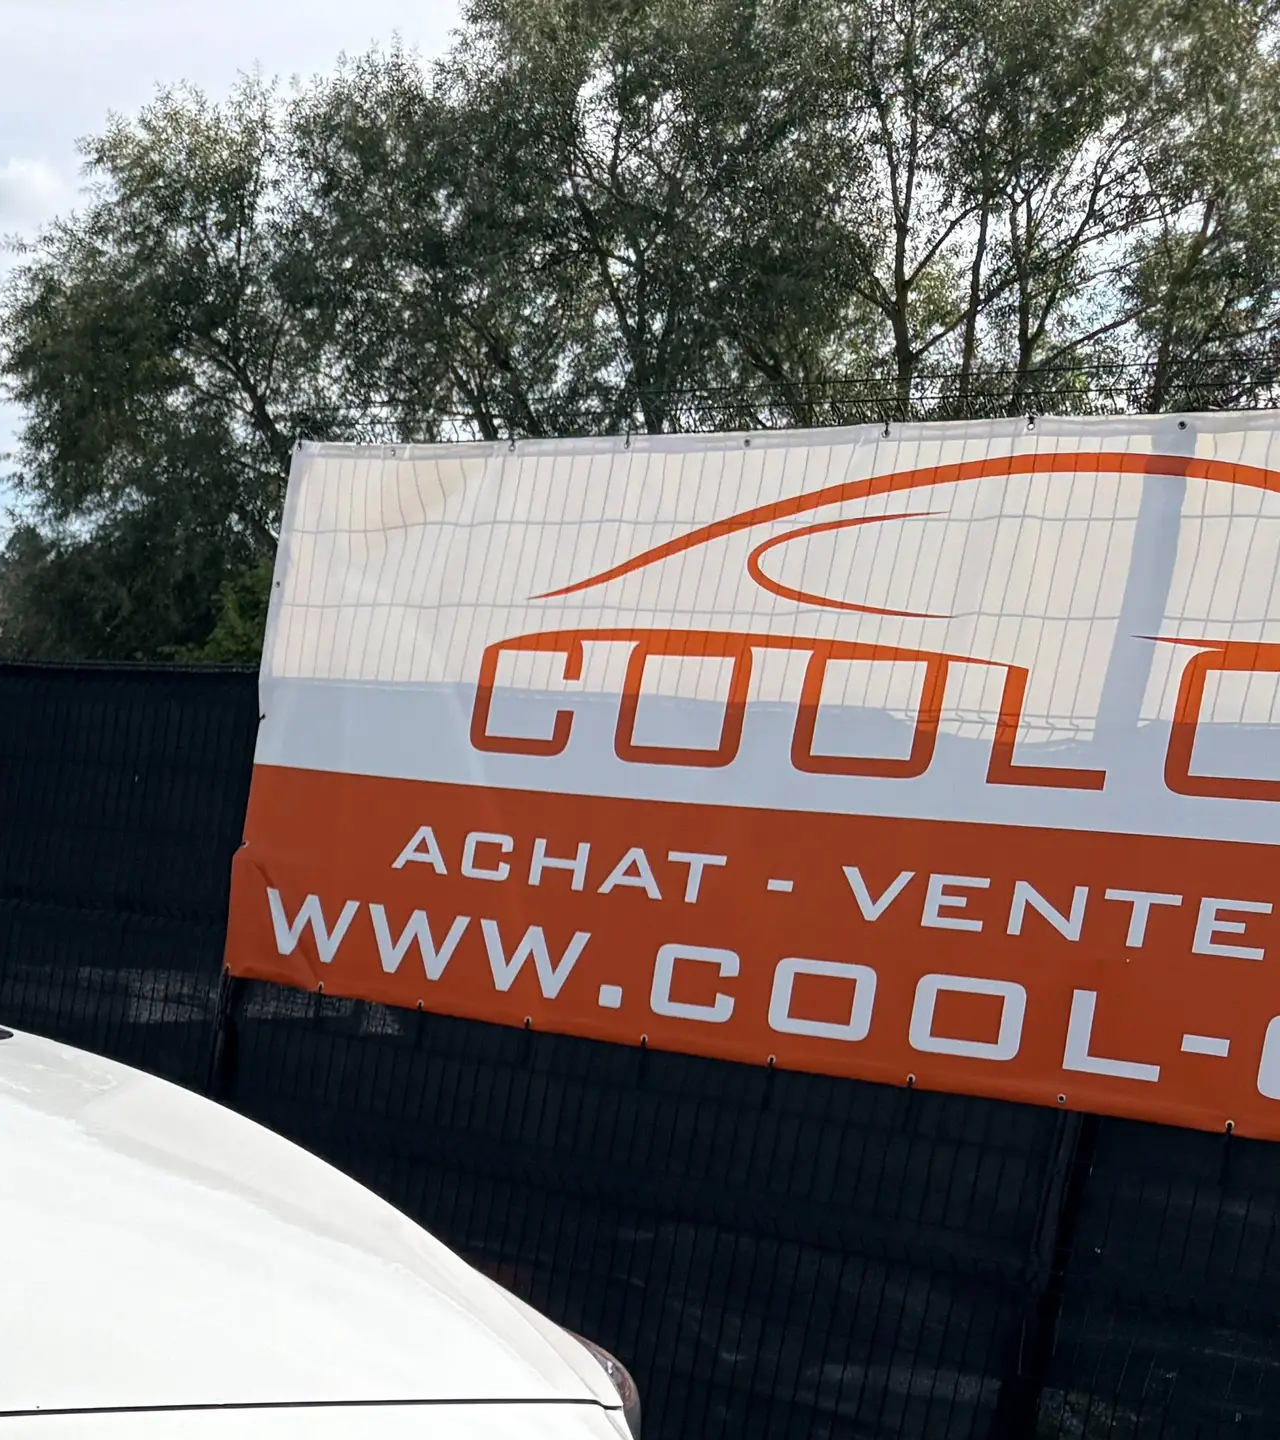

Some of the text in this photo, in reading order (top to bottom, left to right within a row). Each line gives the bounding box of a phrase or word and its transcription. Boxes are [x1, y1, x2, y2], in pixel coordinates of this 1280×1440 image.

[470, 629, 1107, 791] COOL
[392, 825, 728, 904] ACHAT
[842, 865, 1274, 961] VENTE
[266, 887, 1280, 1101] WWW.COOL-
